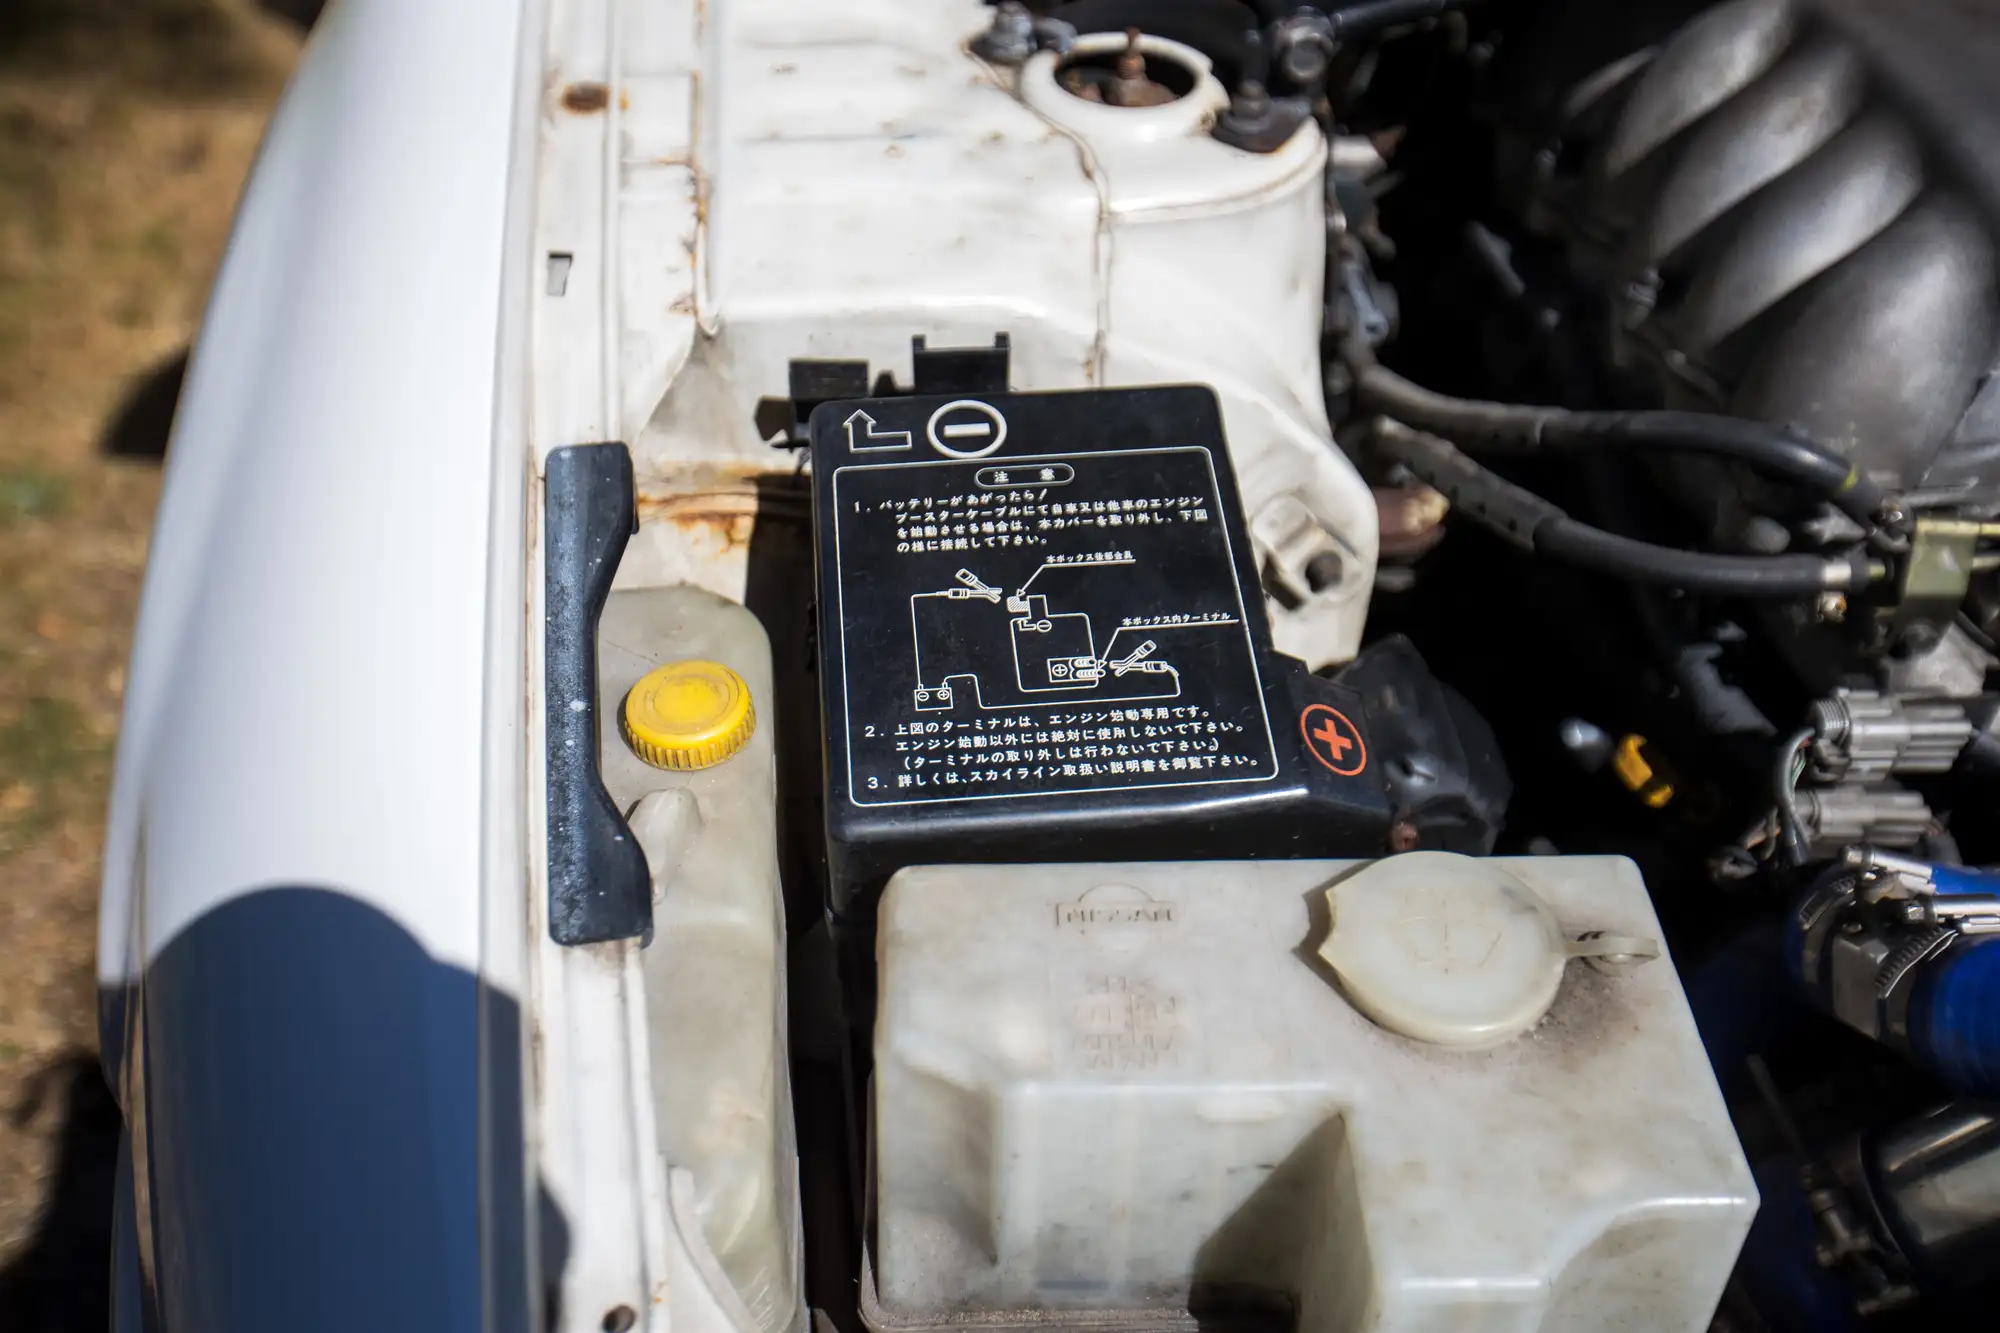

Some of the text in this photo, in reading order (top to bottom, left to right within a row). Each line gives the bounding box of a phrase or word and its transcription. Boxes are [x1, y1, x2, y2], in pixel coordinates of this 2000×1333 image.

[896, 534, 1048, 553] の様に接続して下さい。
[1122, 612, 1231, 626] 本ボックス内ターミナル
[894, 705, 1210, 736] 上図のターミナルは、エンジン始動専用です。
[896, 721, 1243, 752] エンジン始動以外には絶対に使用しないで下さい。
[898, 754, 1258, 788] 詳しくは、スカイライン取扱い説明書を御覧下さい。
